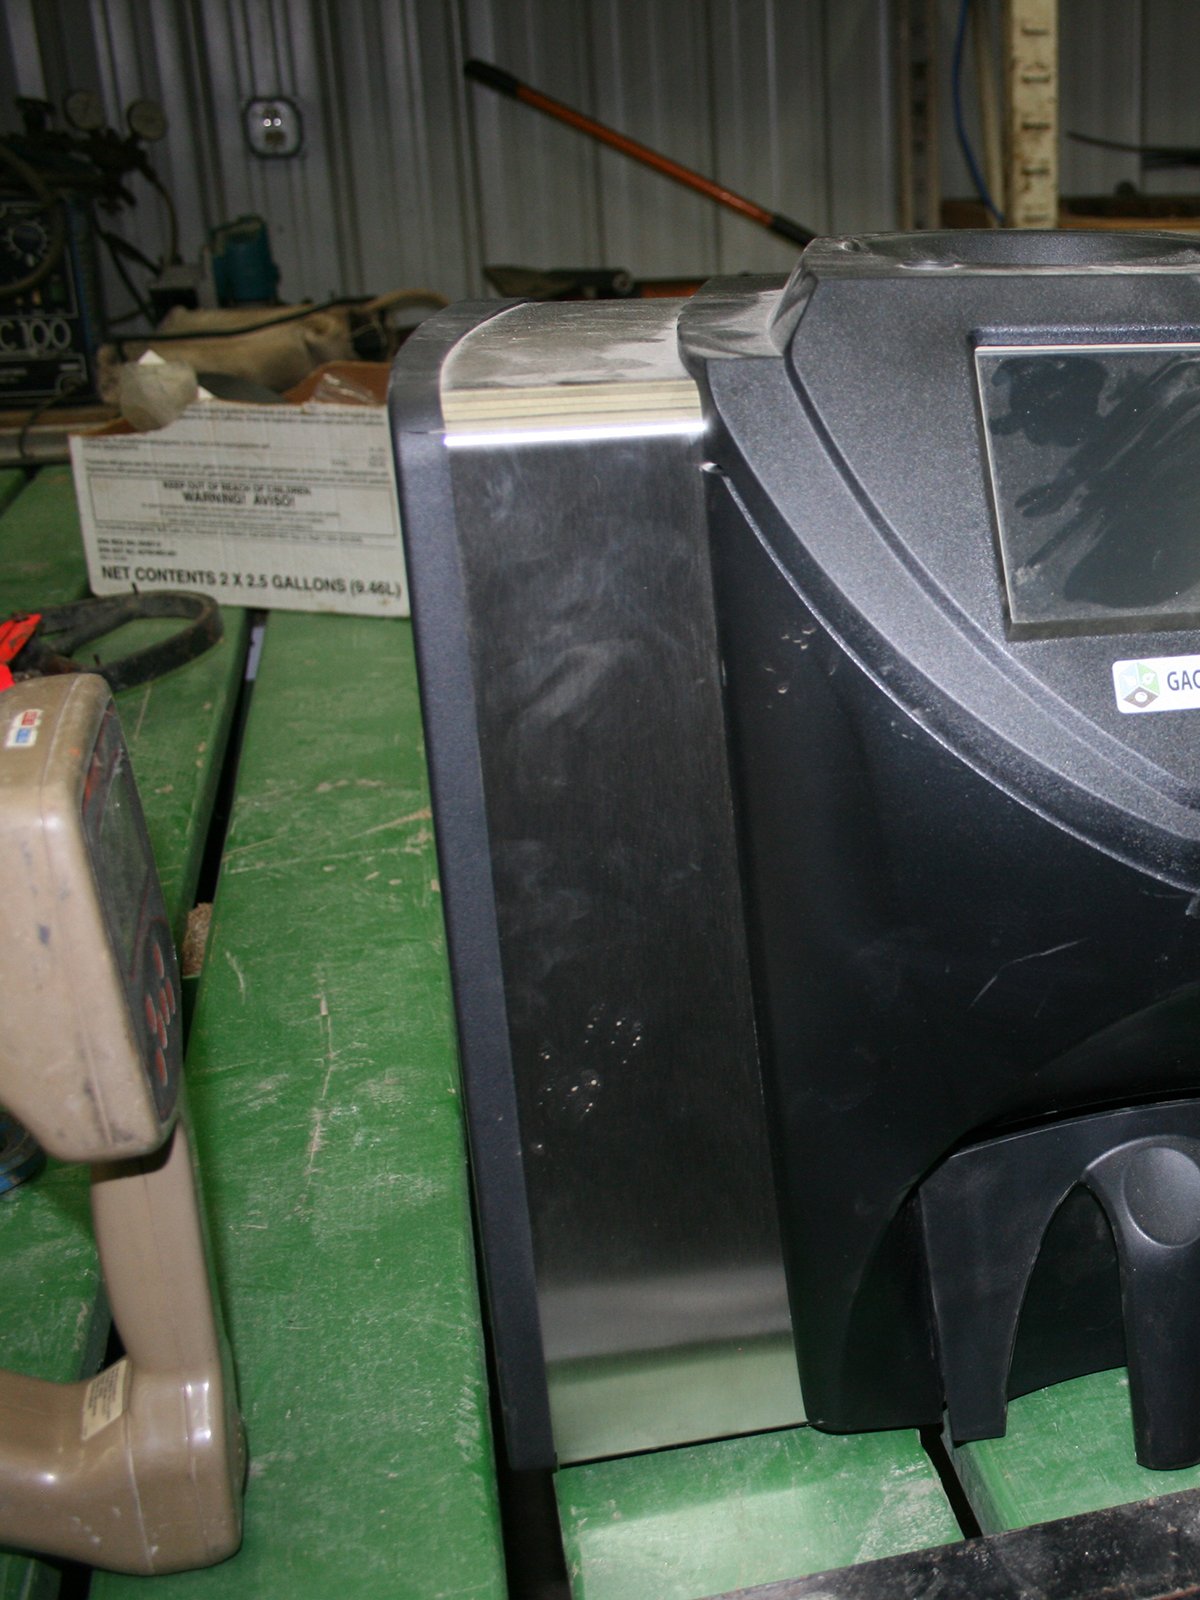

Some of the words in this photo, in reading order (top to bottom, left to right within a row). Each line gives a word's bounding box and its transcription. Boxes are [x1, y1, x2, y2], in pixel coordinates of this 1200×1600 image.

[102, 566, 130, 580] NET
[135, 567, 215, 586] CONTENTS
[220, 572, 229, 586] 2
[232, 573, 243, 587] X
[248, 574, 268, 588] 2.5
[272, 575, 346, 594] GALLONS
